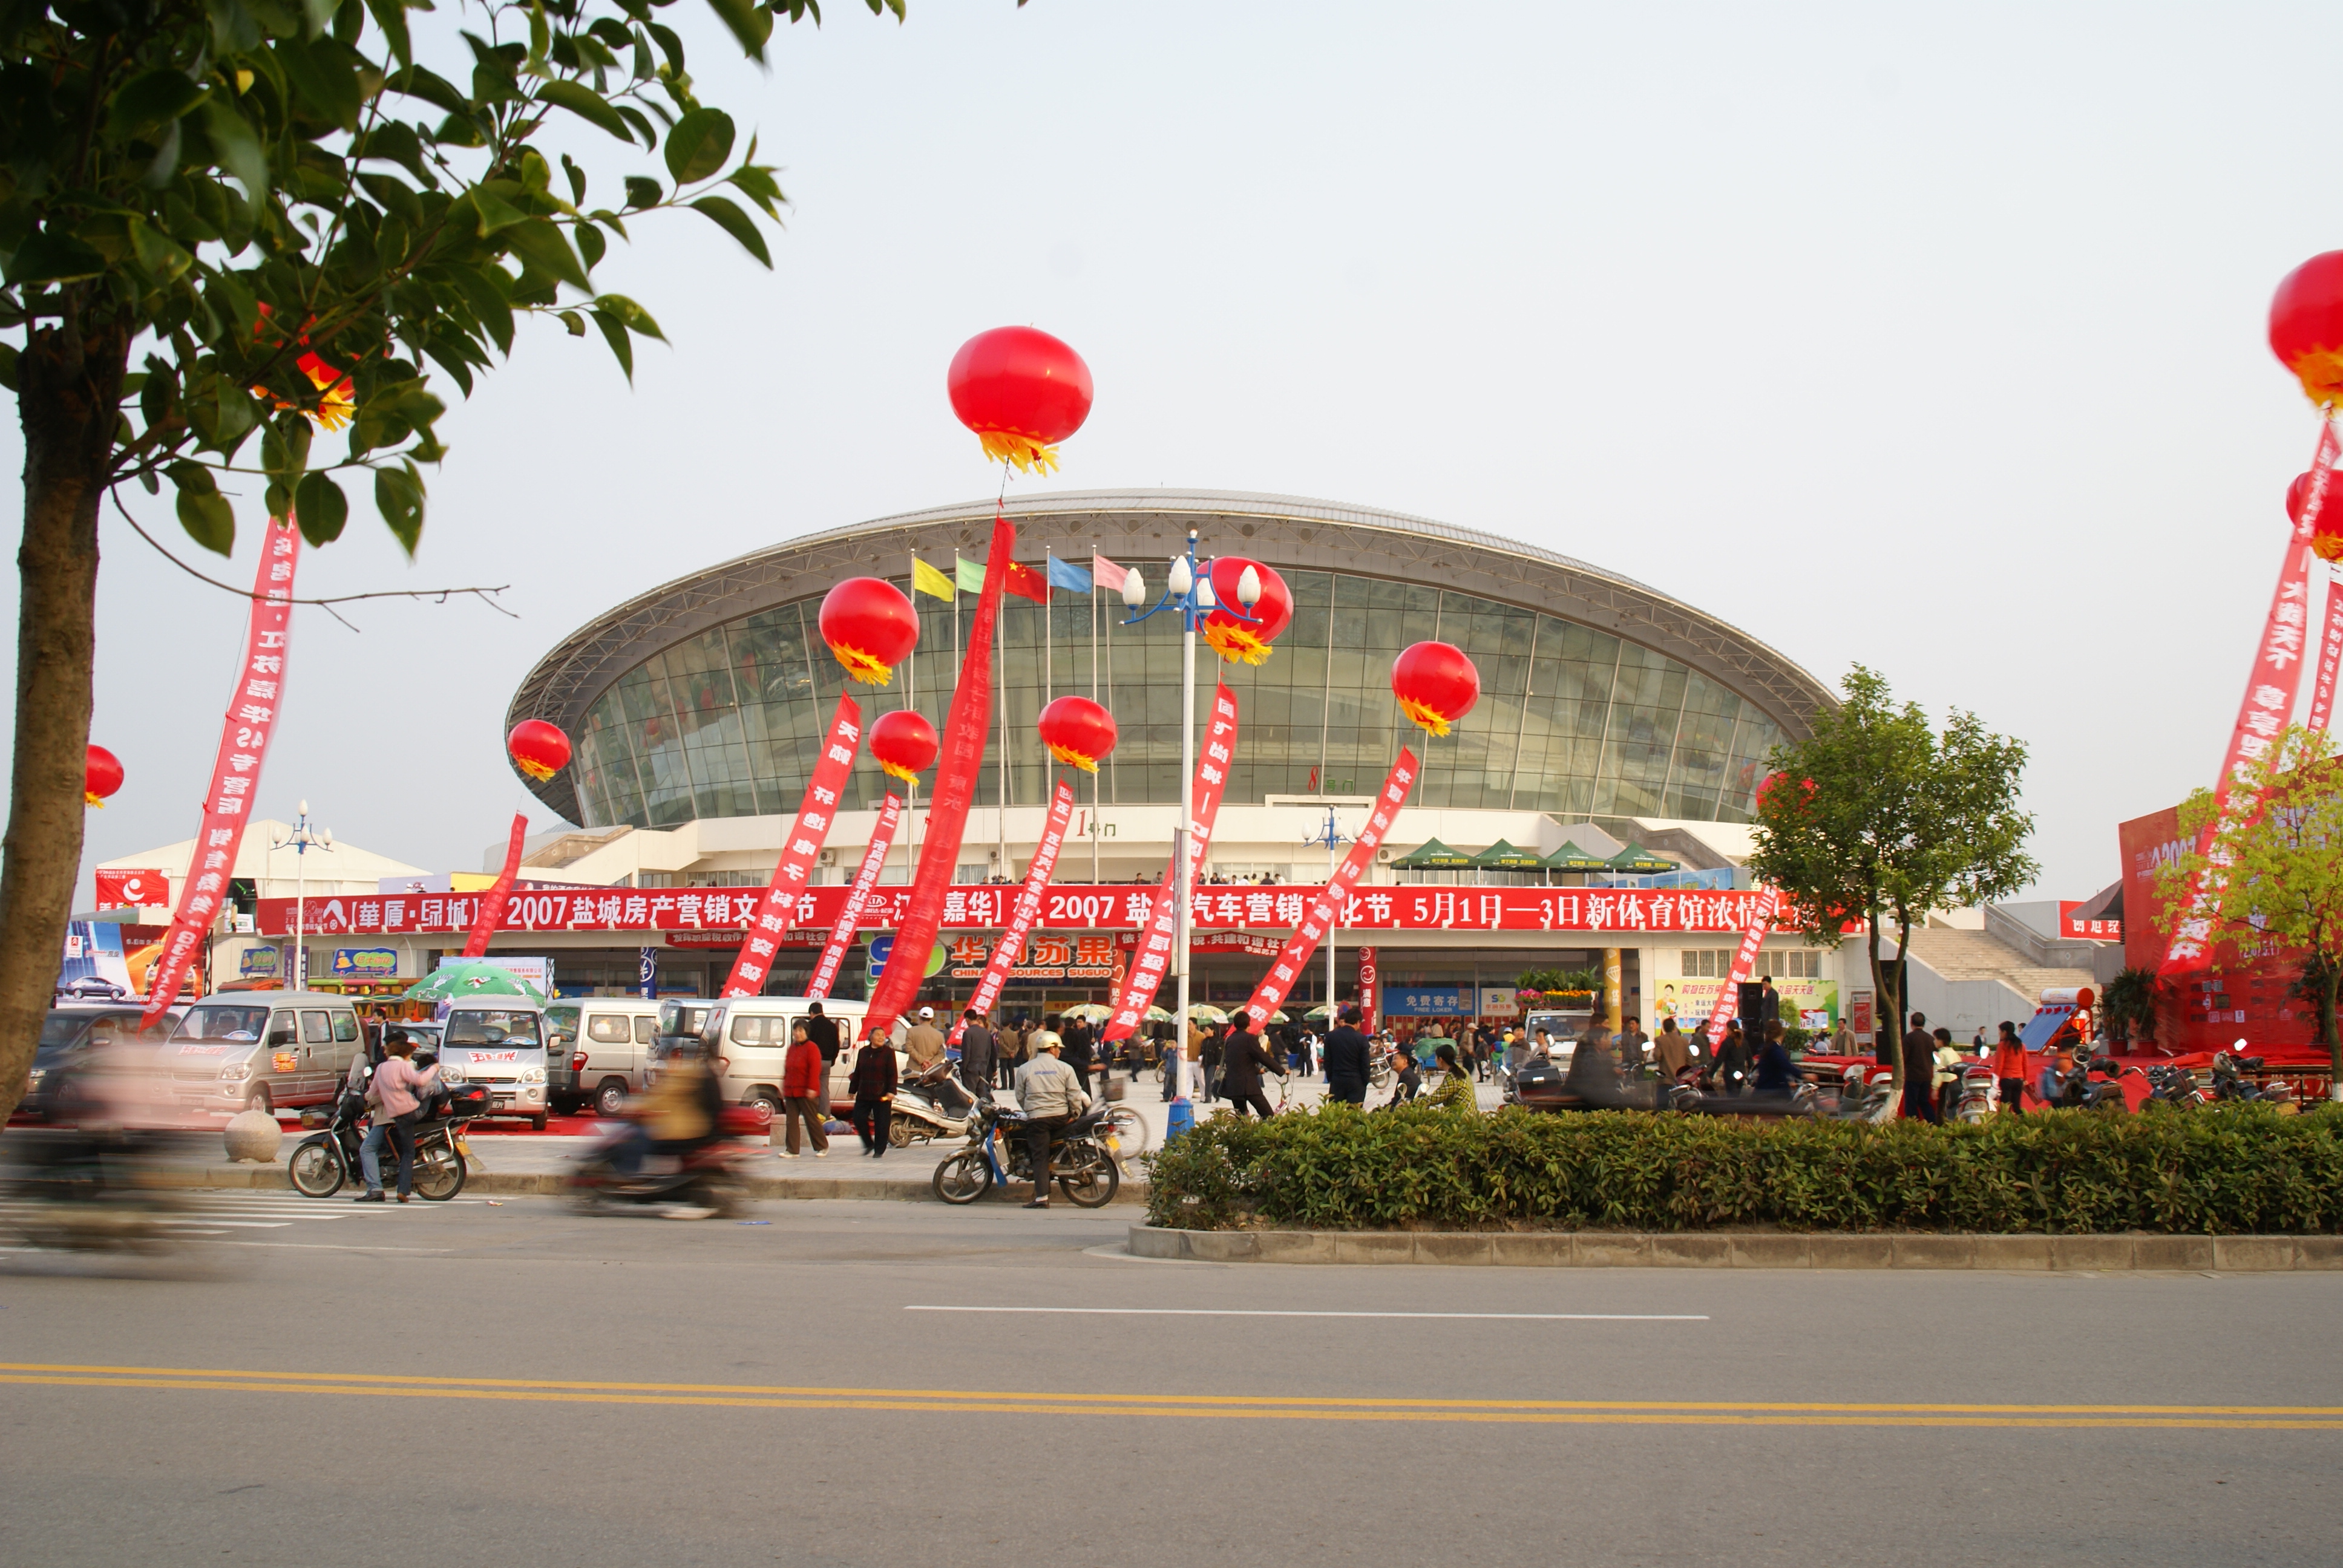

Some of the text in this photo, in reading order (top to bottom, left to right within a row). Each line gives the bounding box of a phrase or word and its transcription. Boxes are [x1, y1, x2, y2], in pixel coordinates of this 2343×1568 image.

[1308, 765, 1354, 792] 8号门
[1050, 896, 1114, 919] 2007
[1125, 892, 1392, 923] 盐汽车营销化节
[356, 956, 392, 964] 巴士咖啡
[1067, 968, 1112, 978] SUGUO
[1406, 995, 1458, 1007] 免费寄存
